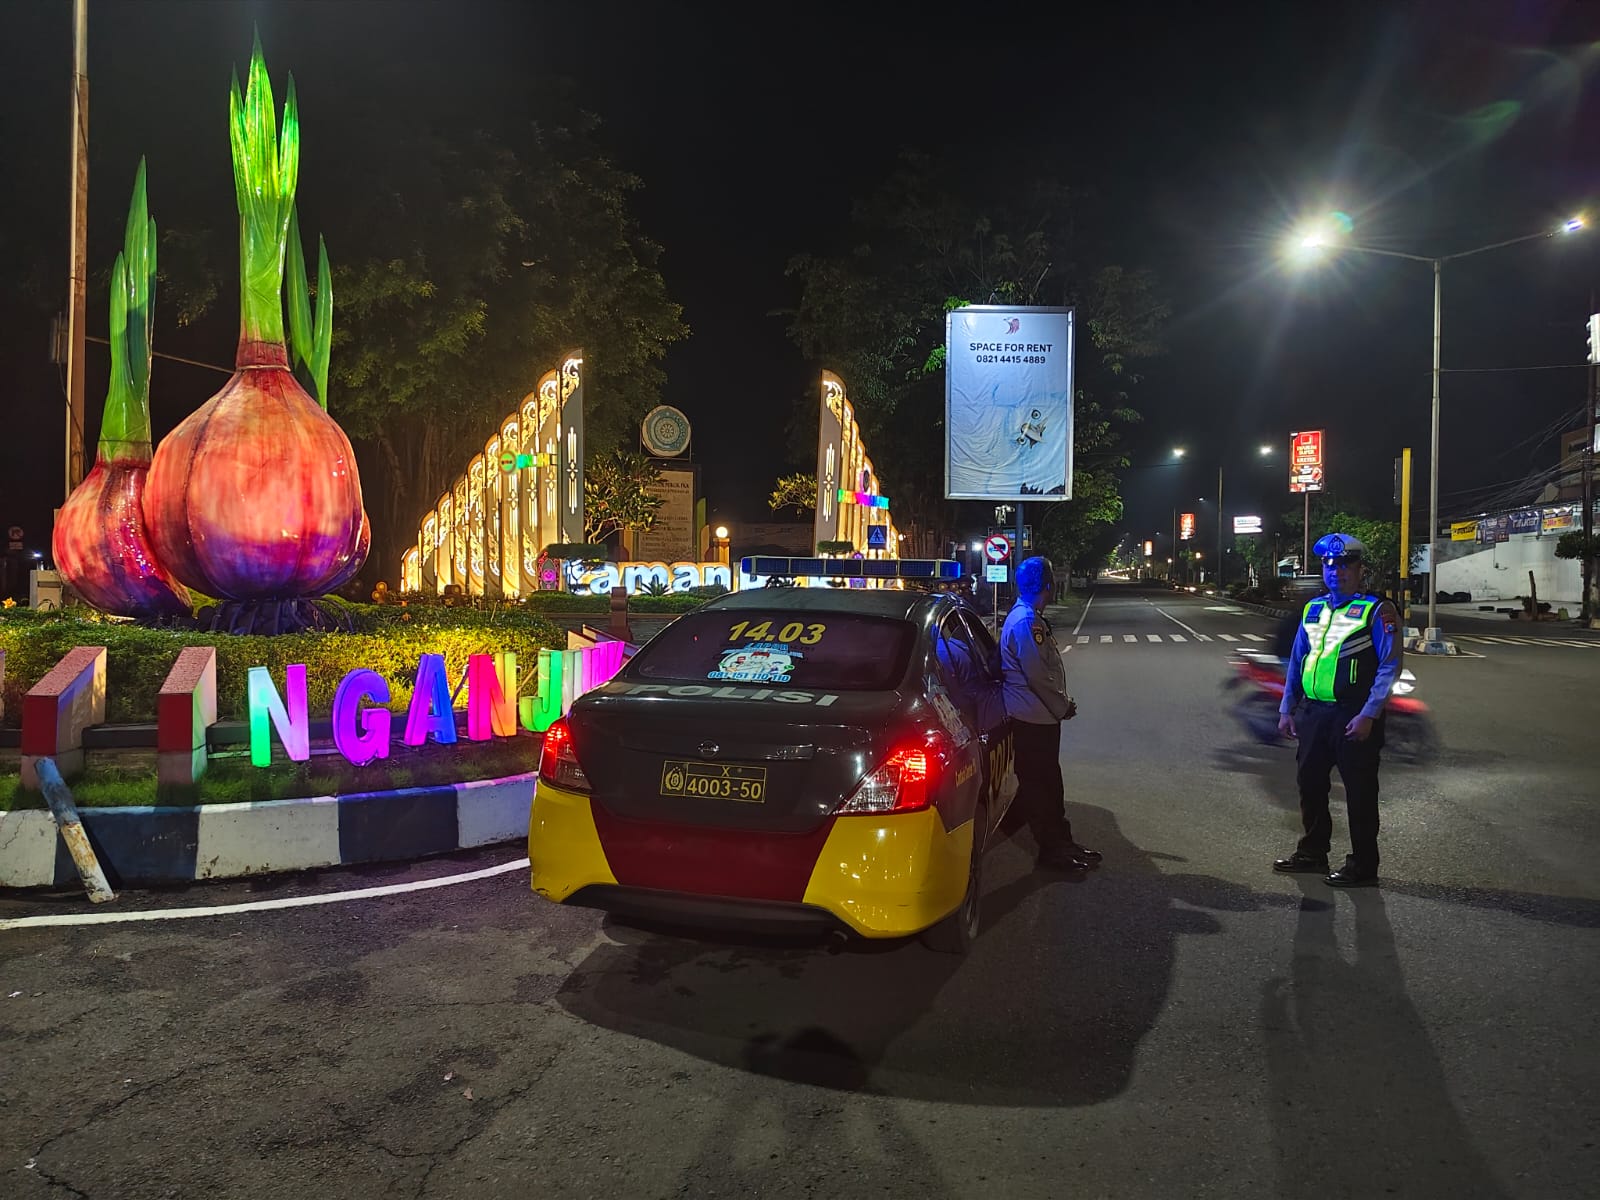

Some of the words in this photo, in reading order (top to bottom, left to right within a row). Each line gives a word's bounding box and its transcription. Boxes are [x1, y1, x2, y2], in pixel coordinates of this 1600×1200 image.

[970, 343, 1002, 352] SPACE
[1005, 343, 1025, 352] FOR
[1027, 343, 1053, 353] RENT
[976, 355, 998, 363] 0821
[1000, 355, 1021, 363] 4415
[1023, 356, 1046, 364] 4889
[728, 620, 826, 645] 14.03
[708, 671, 728, 679] 081
[732, 672, 749, 680] 151
[752, 673, 770, 681] 110
[771, 674, 791, 682] 110
[626, 684, 839, 707] POLISI
[721, 767, 730, 777] X
[687, 777, 764, 800] 4003-50
